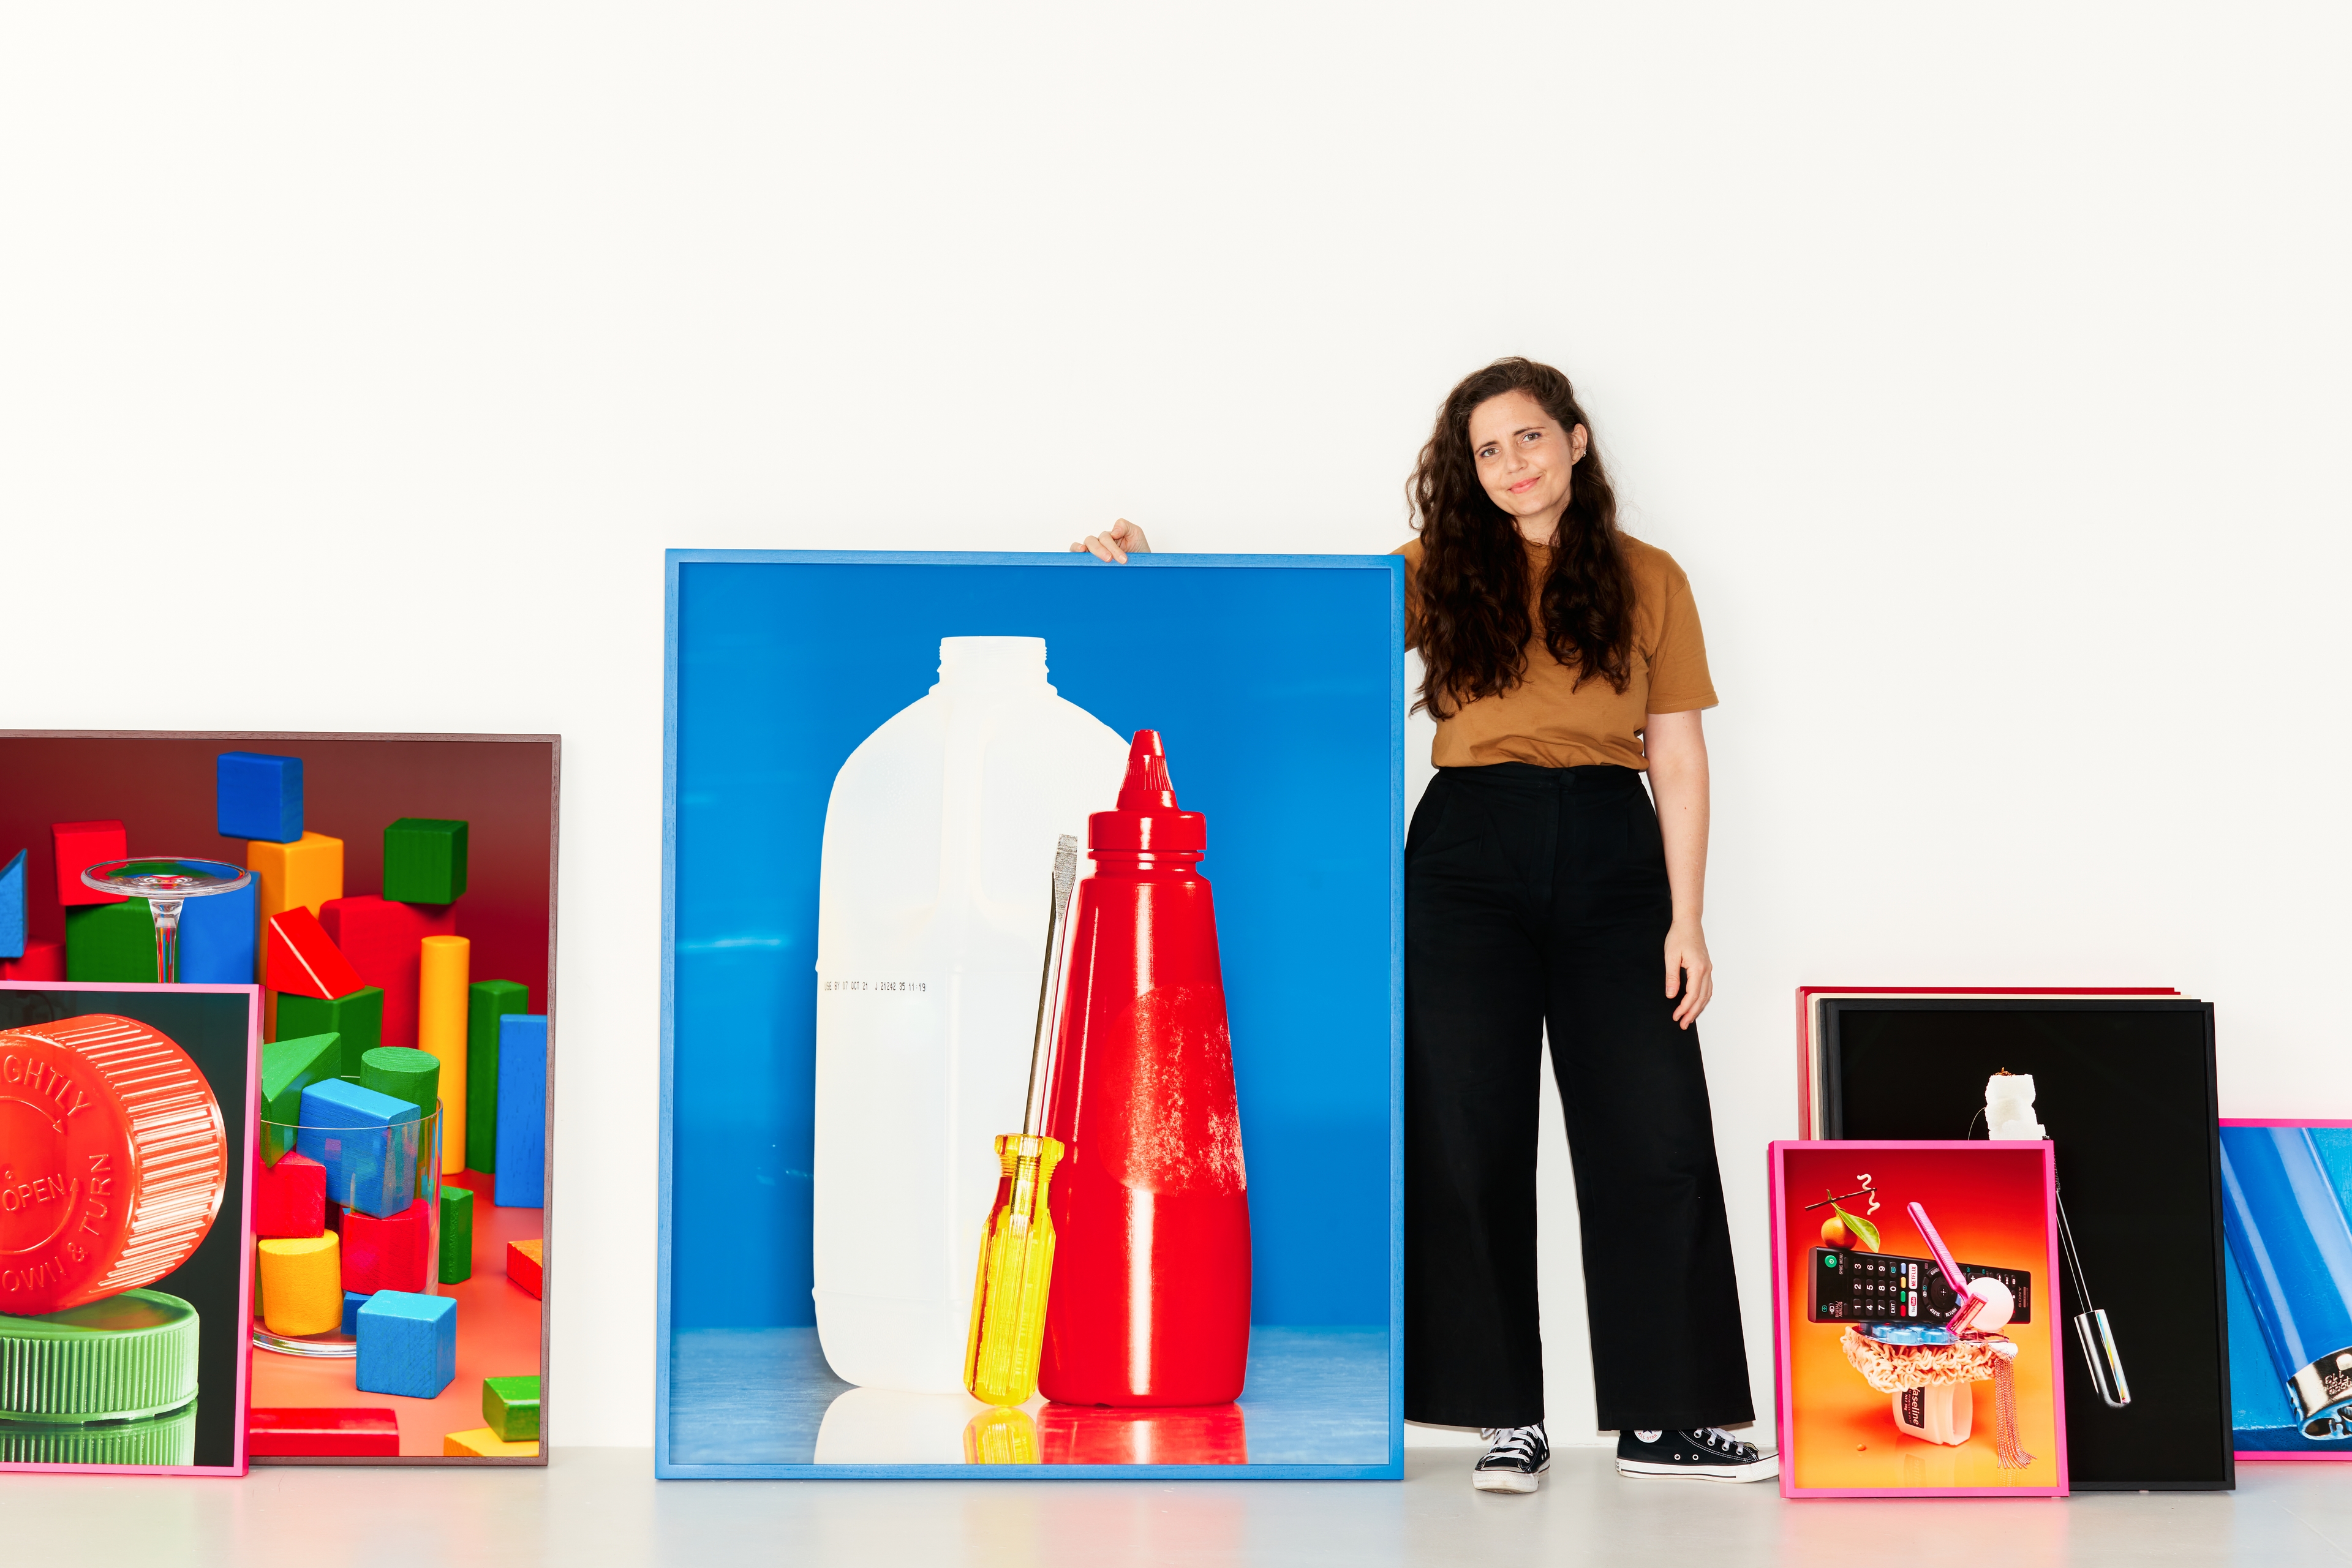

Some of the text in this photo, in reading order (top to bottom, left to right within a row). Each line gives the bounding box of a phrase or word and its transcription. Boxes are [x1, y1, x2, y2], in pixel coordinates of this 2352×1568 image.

[834, 981, 840, 990] BY
[842, 981, 848, 990] 07
[851, 981, 859, 990] OCT
[862, 981, 868, 990] 21
[875, 982, 878, 990] J
[880, 982, 896, 990] 21242
[899, 982, 905, 990] 35
[908, 982, 926, 992] 11:19
[2, 1174, 65, 1212] OPEN
[67, 1242, 89, 1263] &
[78, 1153, 111, 1236] TURN
[1929, 1308, 1940, 1317] SLEEP
[1945, 1307, 1958, 1317] RETURN
[2325, 1370, 2345, 1384] 113
